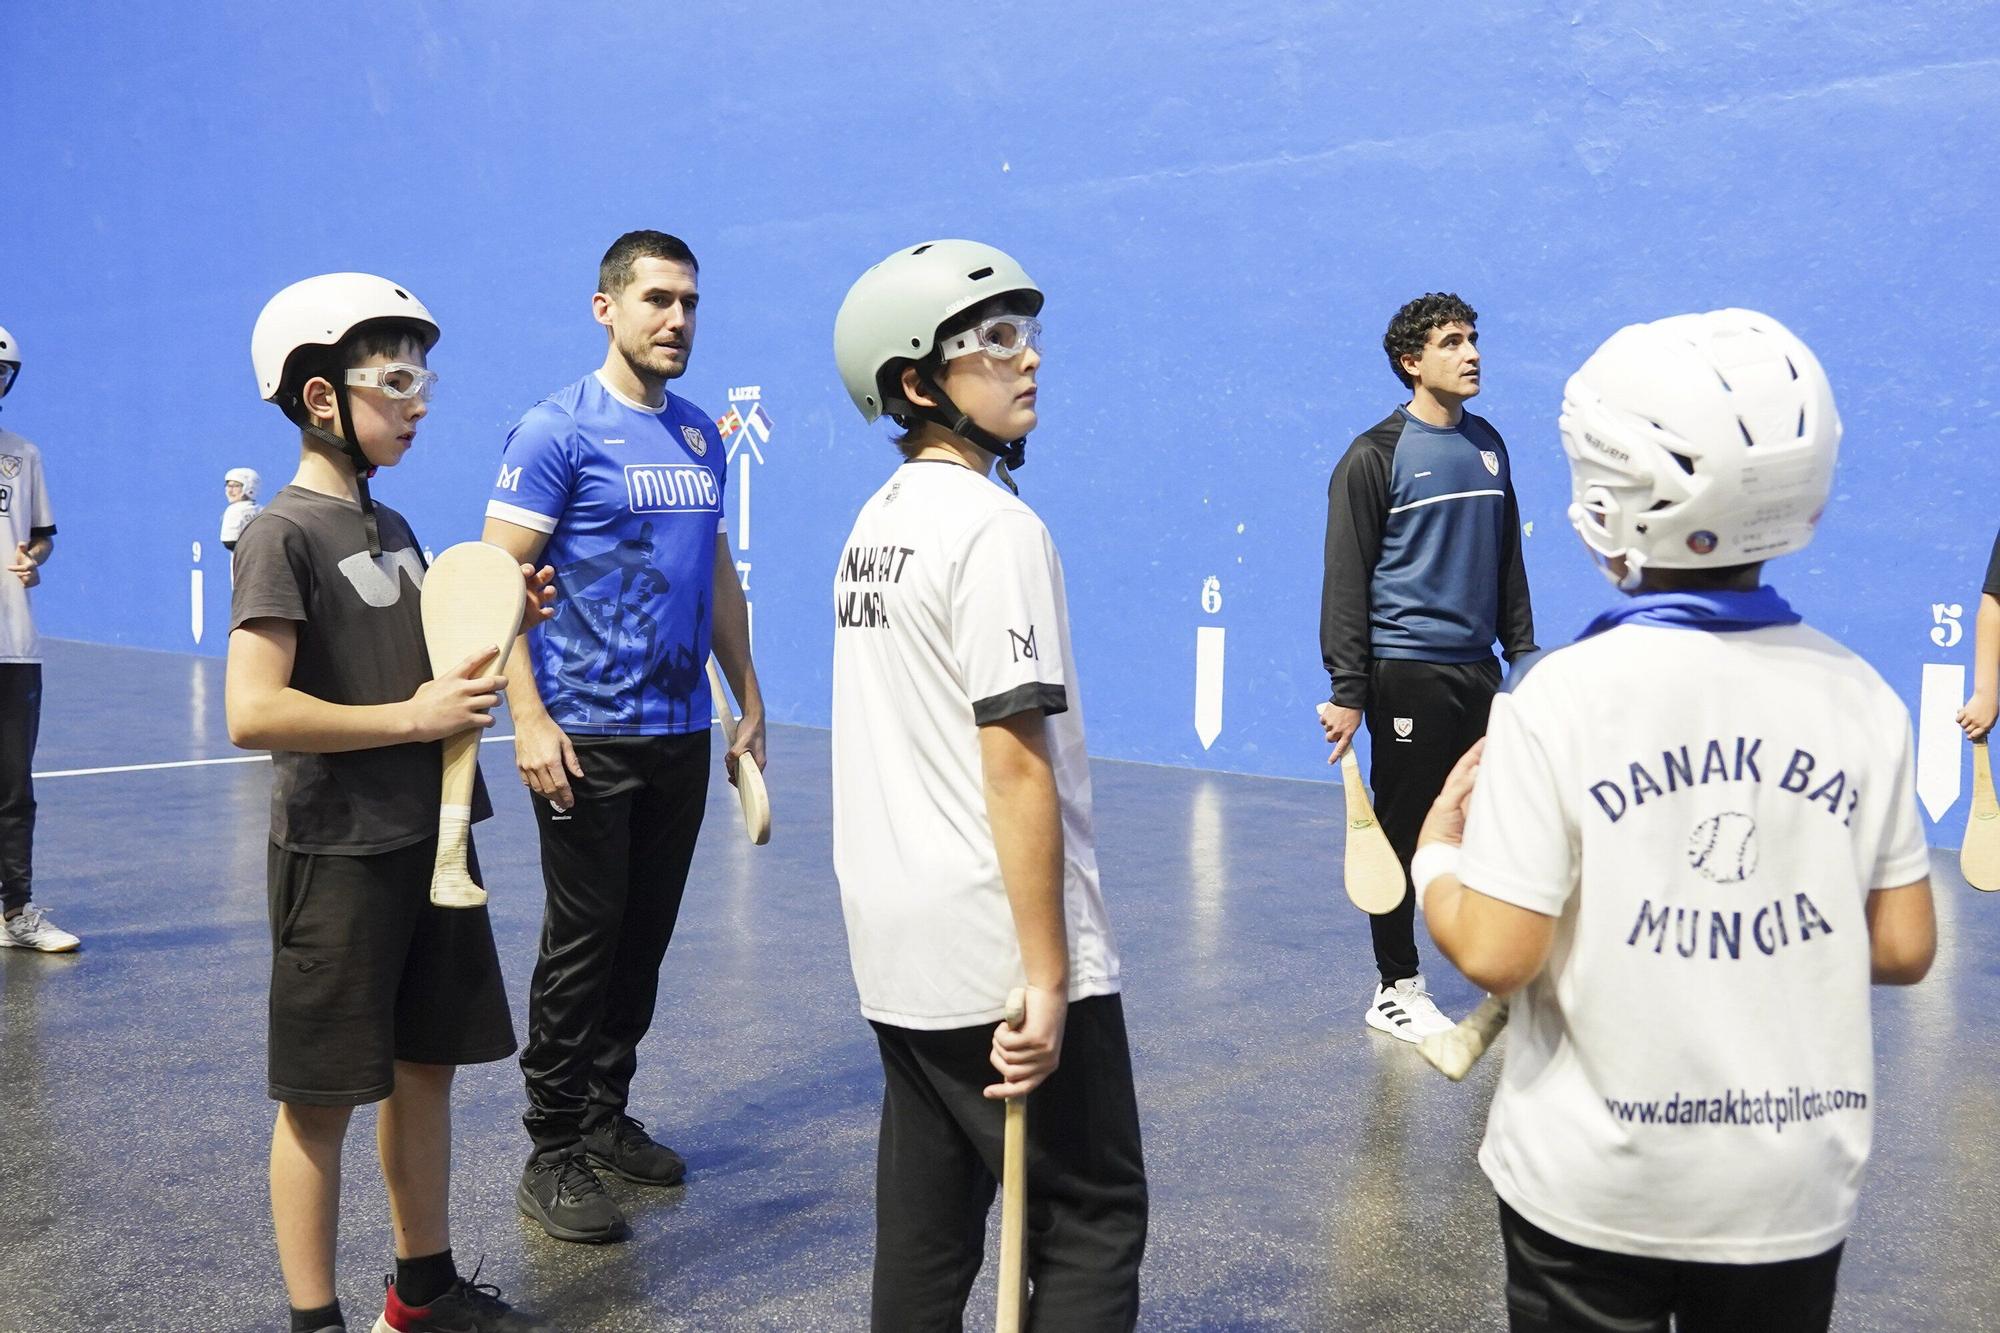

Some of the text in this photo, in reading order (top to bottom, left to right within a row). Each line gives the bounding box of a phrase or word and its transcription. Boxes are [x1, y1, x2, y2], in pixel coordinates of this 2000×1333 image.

[728, 385, 761, 401] LUZE
[632, 469, 717, 507] mume
[191, 541, 202, 563] 9
[736, 560, 752, 590] 7
[1201, 575, 1222, 614] 6
[1929, 603, 1963, 648] 5
[1588, 736, 1763, 824] DANAK
[1626, 892, 1834, 960] MUNGIA
